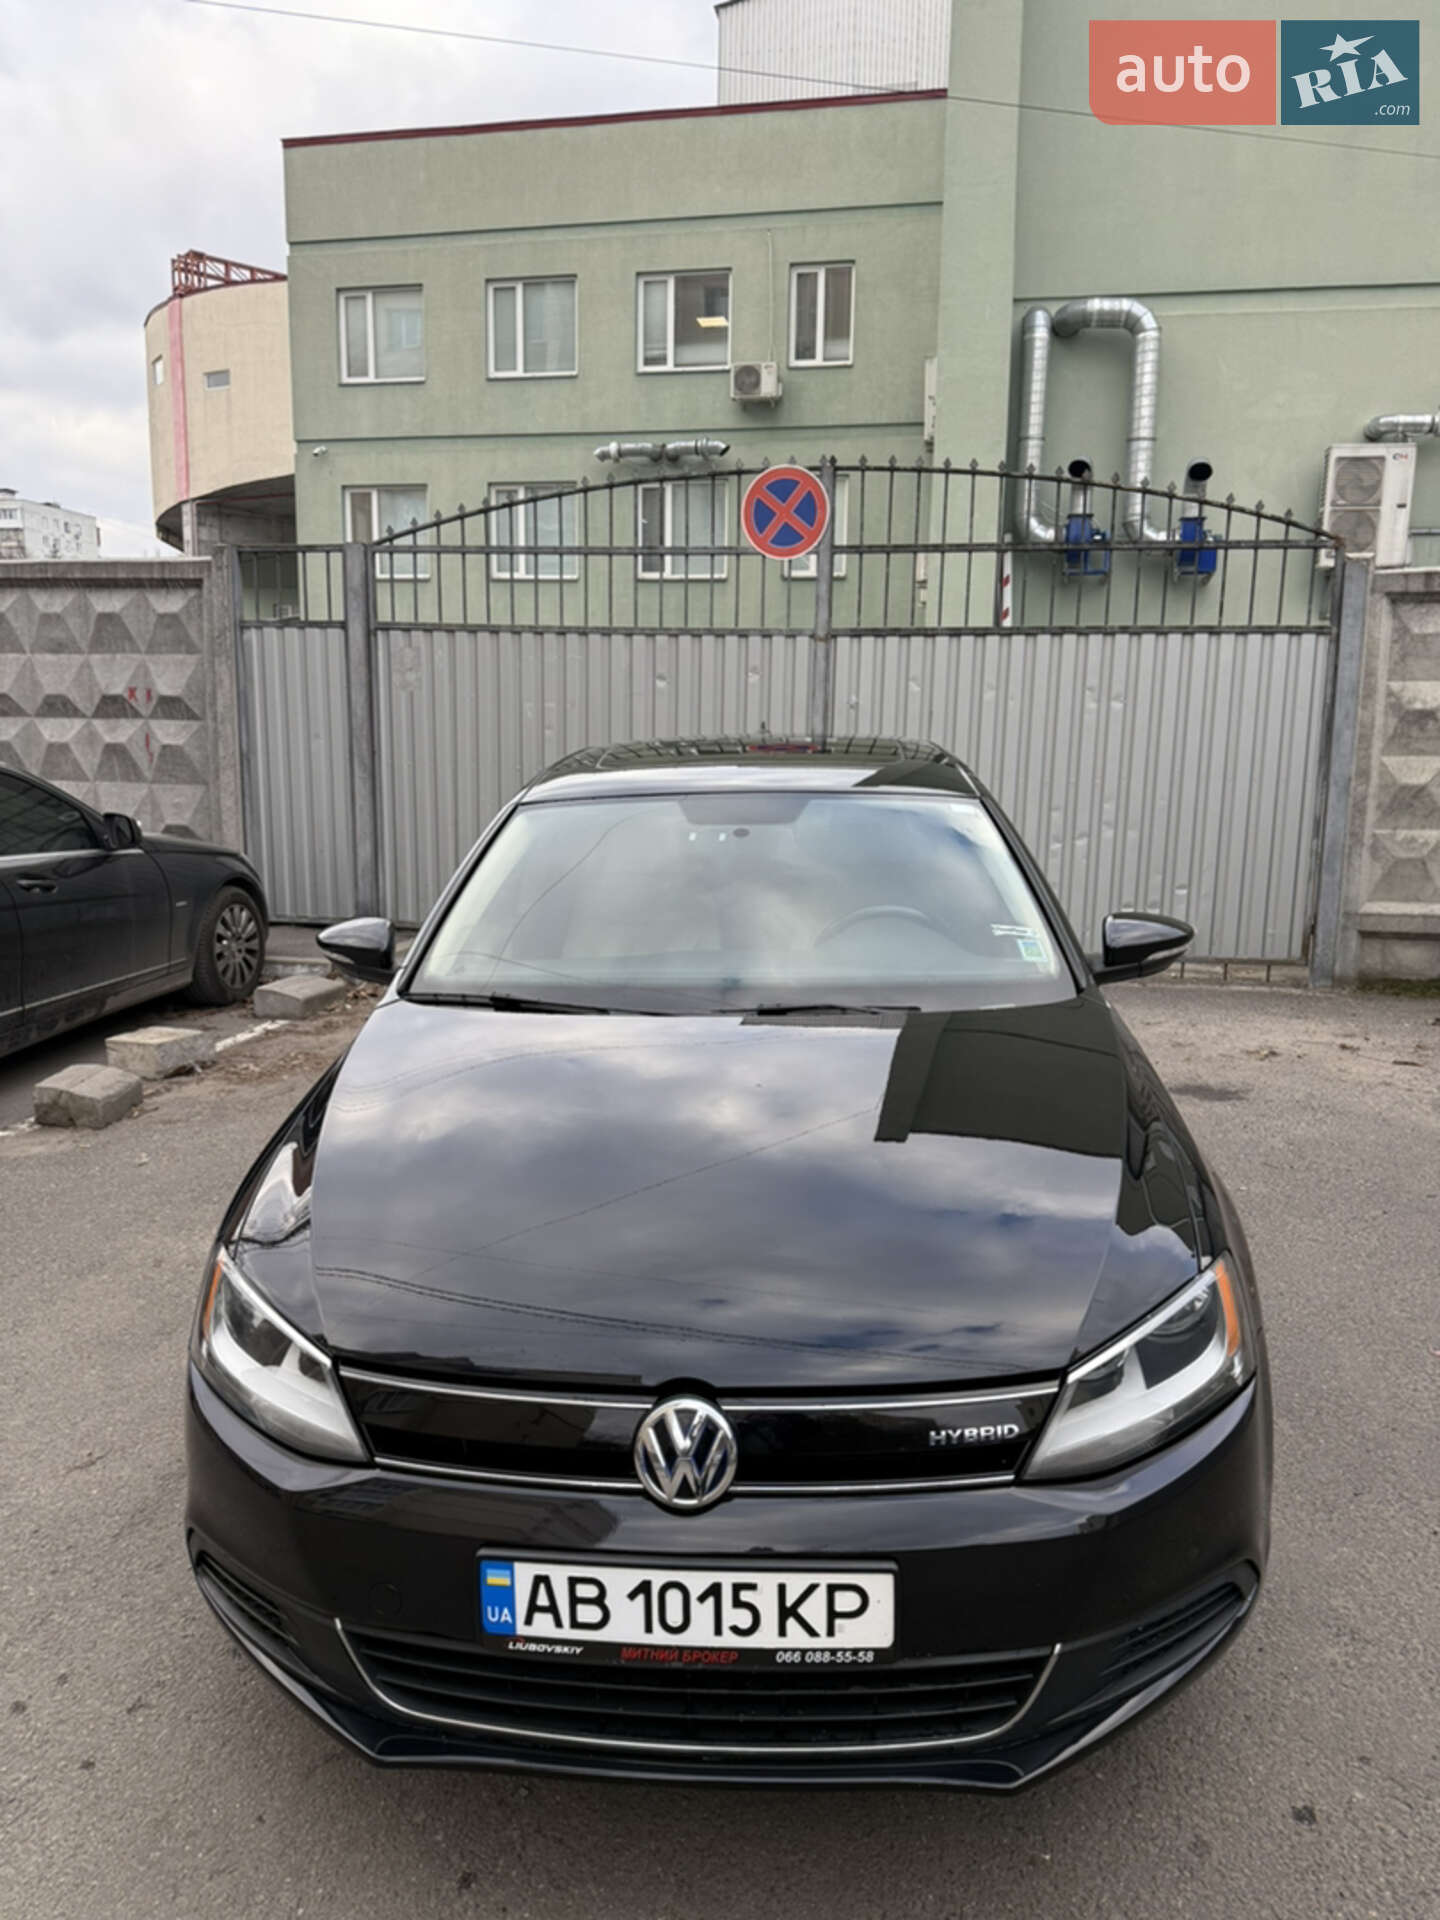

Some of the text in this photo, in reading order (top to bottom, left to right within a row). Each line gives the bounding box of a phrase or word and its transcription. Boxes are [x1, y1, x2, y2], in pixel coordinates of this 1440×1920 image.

[929, 1423, 1020, 1446] HYBRID
[486, 1605, 513, 1625] UA
[523, 1574, 870, 1639] AB 1015 KP
[507, 1639, 584, 1655] LIUBOVSKIY
[620, 1645, 739, 1664] МИТНИЙ БРОКЕР
[775, 1650, 875, 1664] 066 088-55-58
